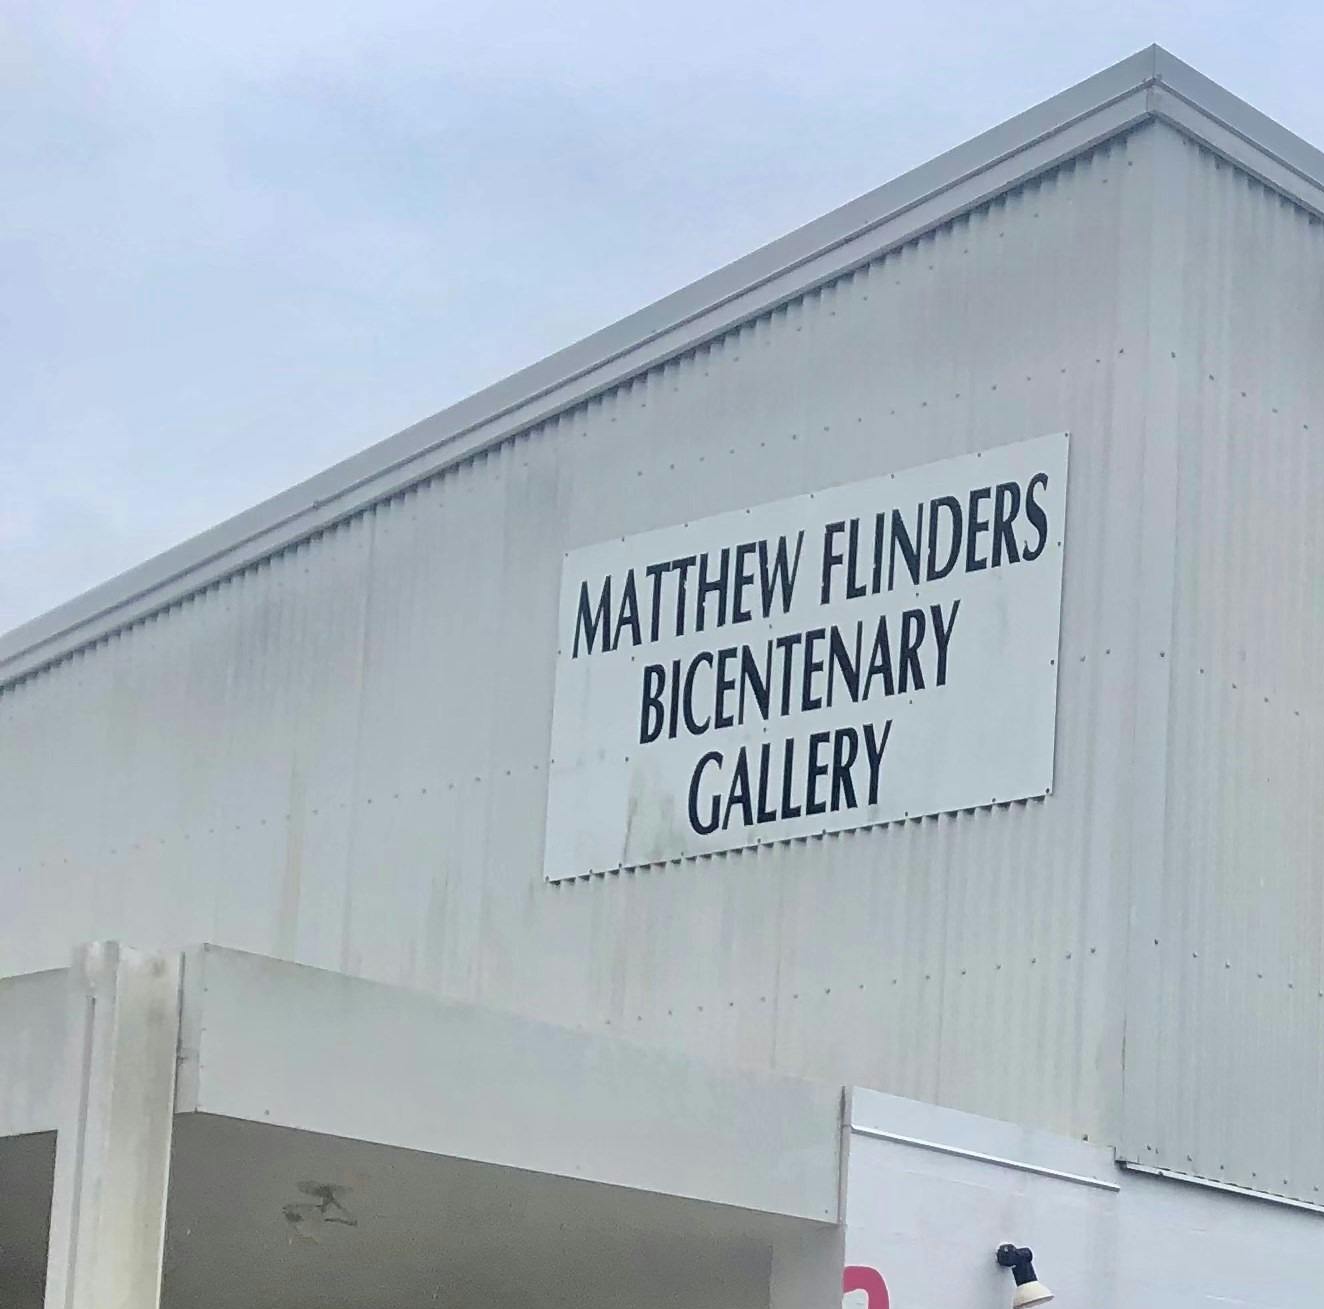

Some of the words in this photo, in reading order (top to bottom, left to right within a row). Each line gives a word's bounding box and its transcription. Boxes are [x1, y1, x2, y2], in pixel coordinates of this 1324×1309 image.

[572, 530, 805, 659] MATTHEW
[820, 472, 1049, 605] FLINDERS
[639, 600, 961, 744] BICENTENARY
[687, 719, 893, 836] GALLERY
